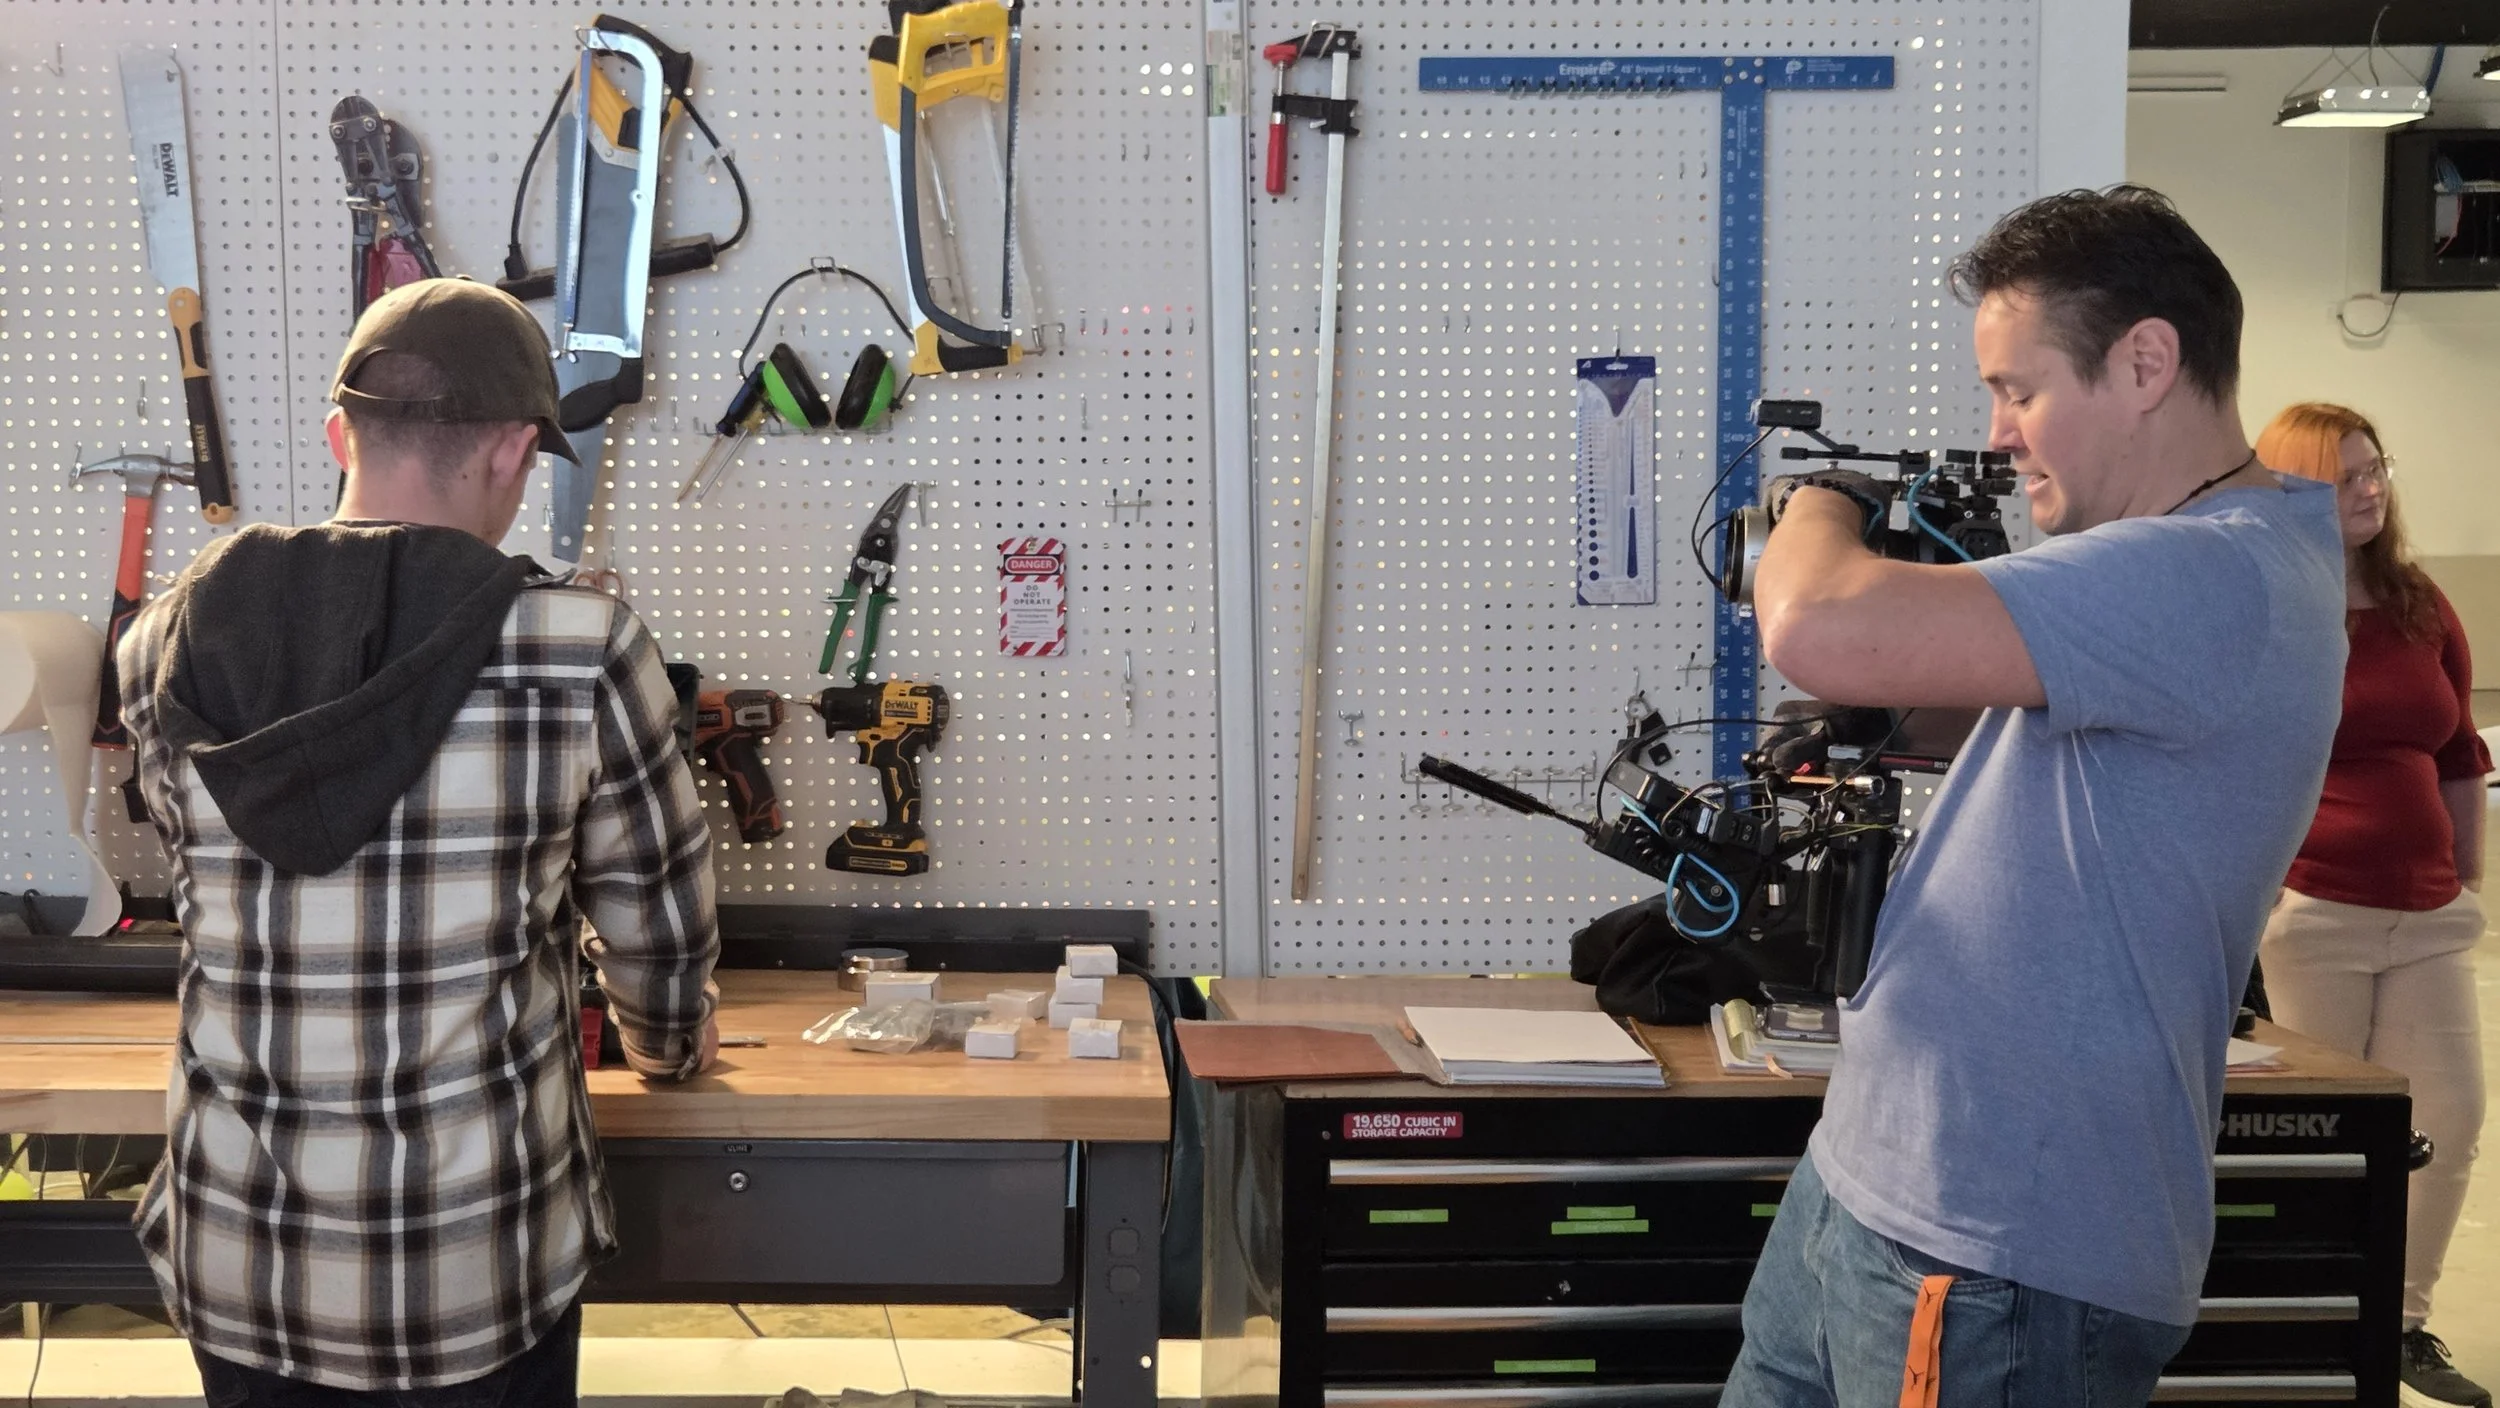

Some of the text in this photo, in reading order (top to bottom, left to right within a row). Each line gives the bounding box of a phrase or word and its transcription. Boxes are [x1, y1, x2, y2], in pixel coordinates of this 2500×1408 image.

[1559, 63, 1609, 77] Empire
[1011, 560, 1052, 569] DANGER
[1352, 1114, 1456, 1129] 19,650 CUBIC IN
[2227, 1113, 2340, 1137] HUSKY
[1352, 1127, 1448, 1138] STORAGE CAPACITY
